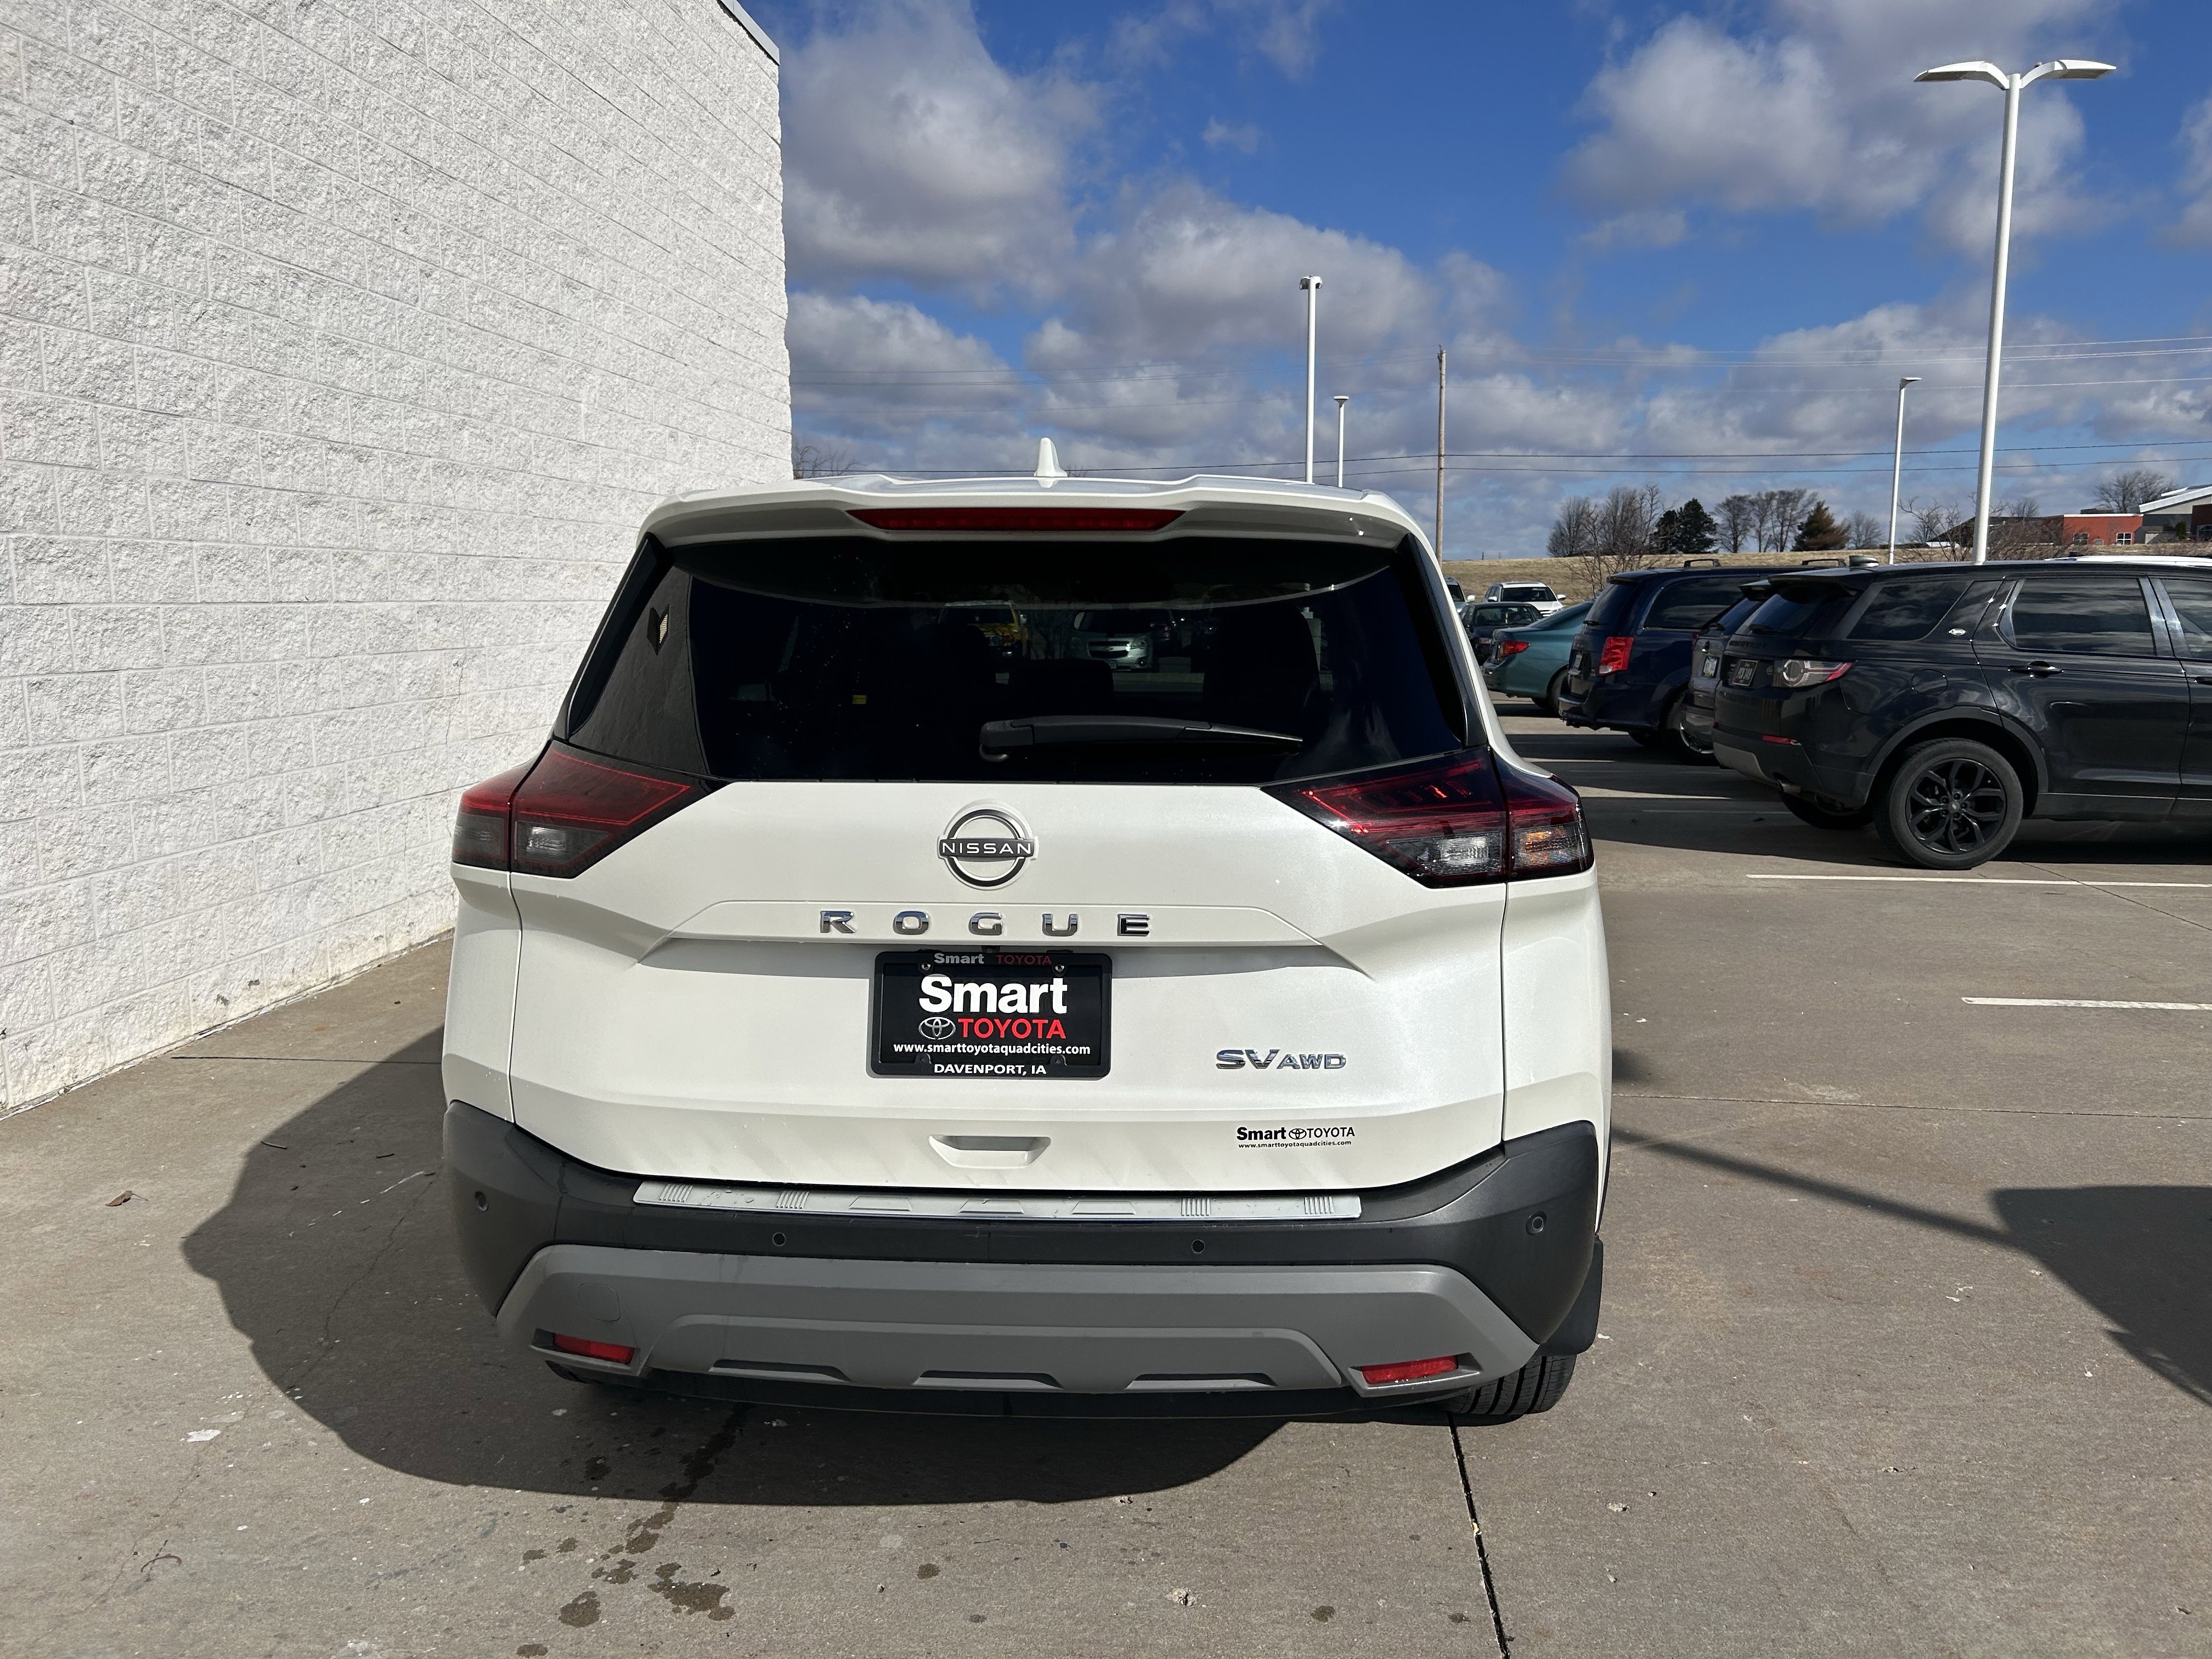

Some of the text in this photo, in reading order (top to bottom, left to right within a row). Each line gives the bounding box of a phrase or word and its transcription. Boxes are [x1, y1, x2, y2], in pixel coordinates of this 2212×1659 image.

[941, 841, 1032, 855] NISSAN
[820, 910, 1151, 937] ROGUE
[934, 953, 1052, 965] Smart TOYOTA
[919, 973, 1068, 1014] Smart
[958, 1018, 1066, 1039] TOYOTA
[894, 1043, 1091, 1056] www.smarttoyotaquadcities.com
[1216, 1049, 1346, 1069] SV AWD
[934, 1064, 1047, 1075] DAVENPORT, IA
[1237, 1127, 1355, 1141] Smart TOYOTA
[1238, 1140, 1352, 1149] www.smarttoyotaquadcities.com
